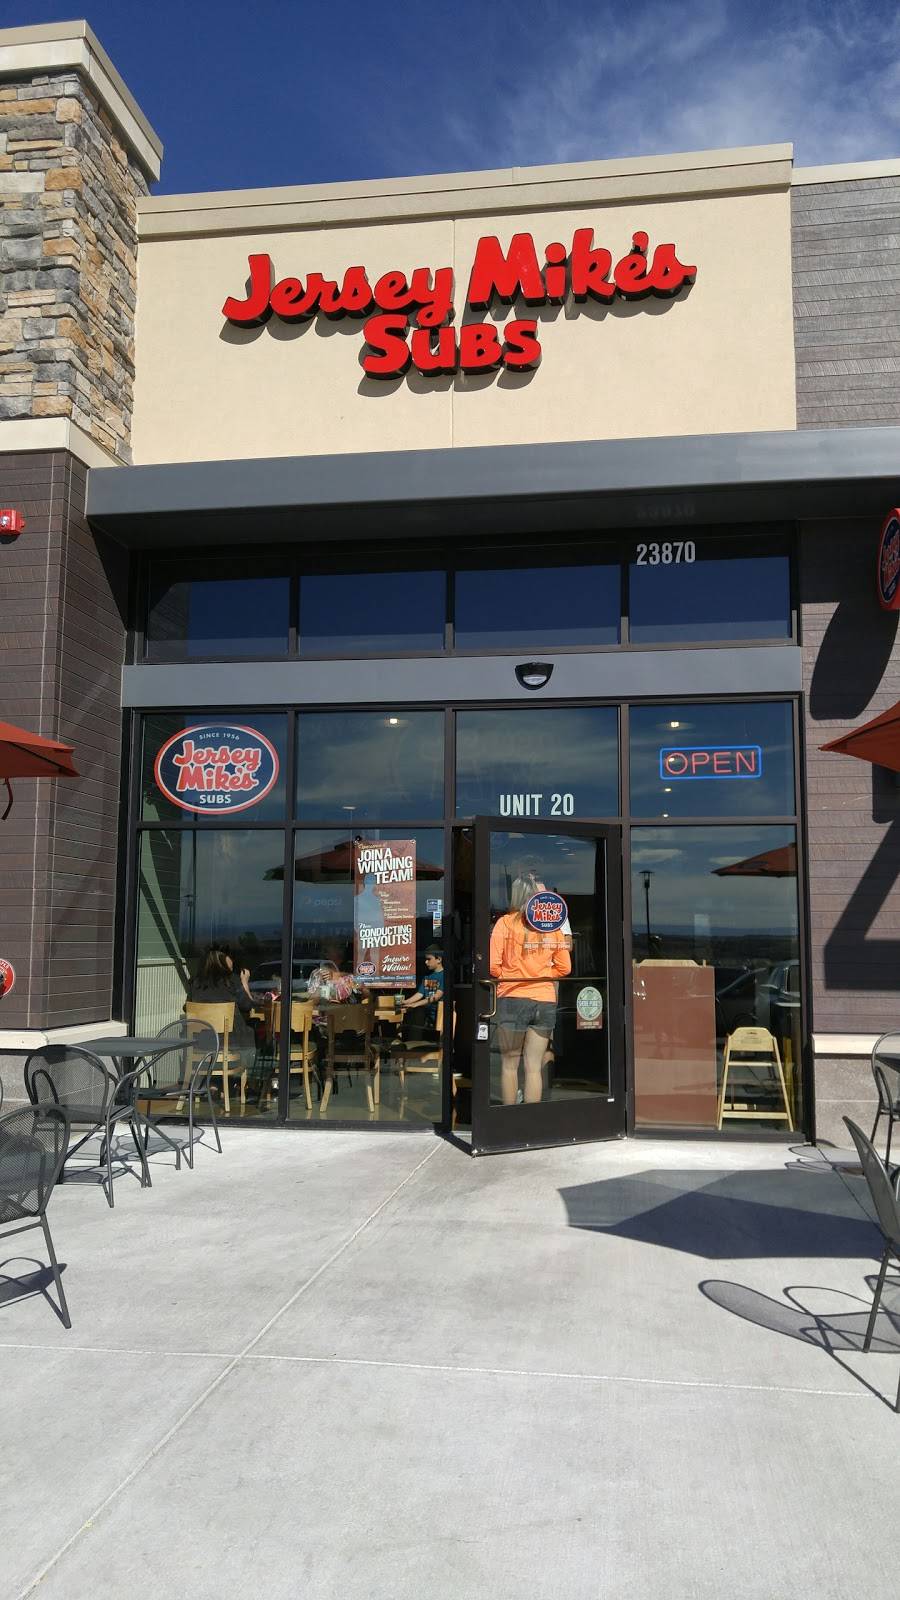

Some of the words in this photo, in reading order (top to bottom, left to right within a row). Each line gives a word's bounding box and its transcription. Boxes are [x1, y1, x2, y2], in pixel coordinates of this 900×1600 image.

[222, 252, 454, 328] Jersey
[467, 227, 698, 305] Mike's
[363, 313, 542, 378] SUBS
[636, 541, 696, 566] 23870
[199, 732, 220, 741] SINCE
[223, 732, 240, 741] 1956
[172, 740, 262, 773] Jersey
[665, 751, 756, 775] OPEN
[176, 764, 260, 793] Mike's
[199, 794, 232, 804] SUBS
[499, 794, 543, 817] UNIT
[550, 793, 575, 816] 20
[357, 848, 383, 862] JOIN
[384, 847, 392, 859] A
[357, 855, 413, 875] WINNING
[374, 868, 413, 885] TEAM!
[531, 899, 563, 914] Jersey
[359, 924, 412, 938] CONDUCTING
[360, 933, 412, 949] TRYOUTS!
